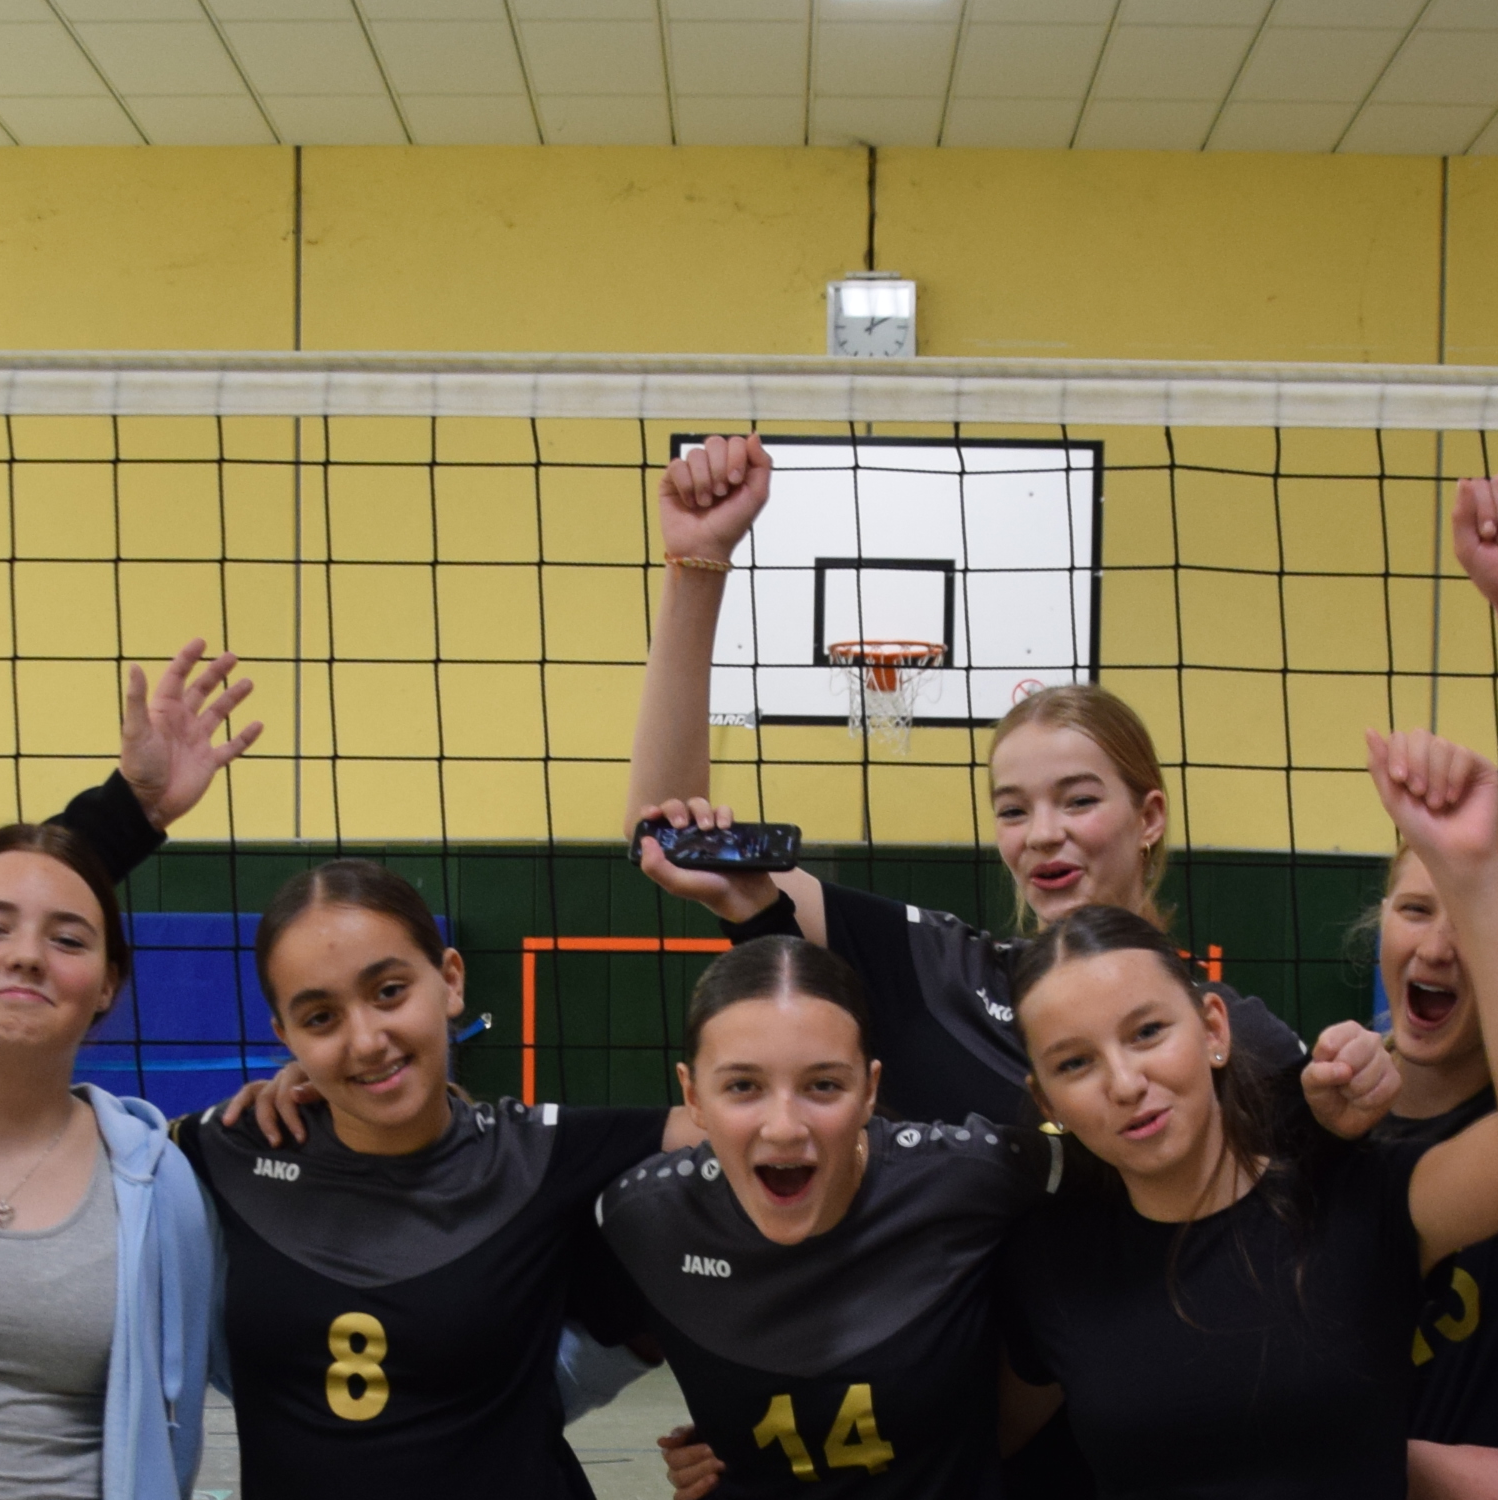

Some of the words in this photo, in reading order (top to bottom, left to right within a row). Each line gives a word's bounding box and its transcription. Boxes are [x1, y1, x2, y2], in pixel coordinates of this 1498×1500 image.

[252, 1156, 301, 1182] JAKO
[681, 1253, 732, 1278] JAKO
[325, 1311, 390, 1421] 8
[753, 1383, 895, 1482] 14
